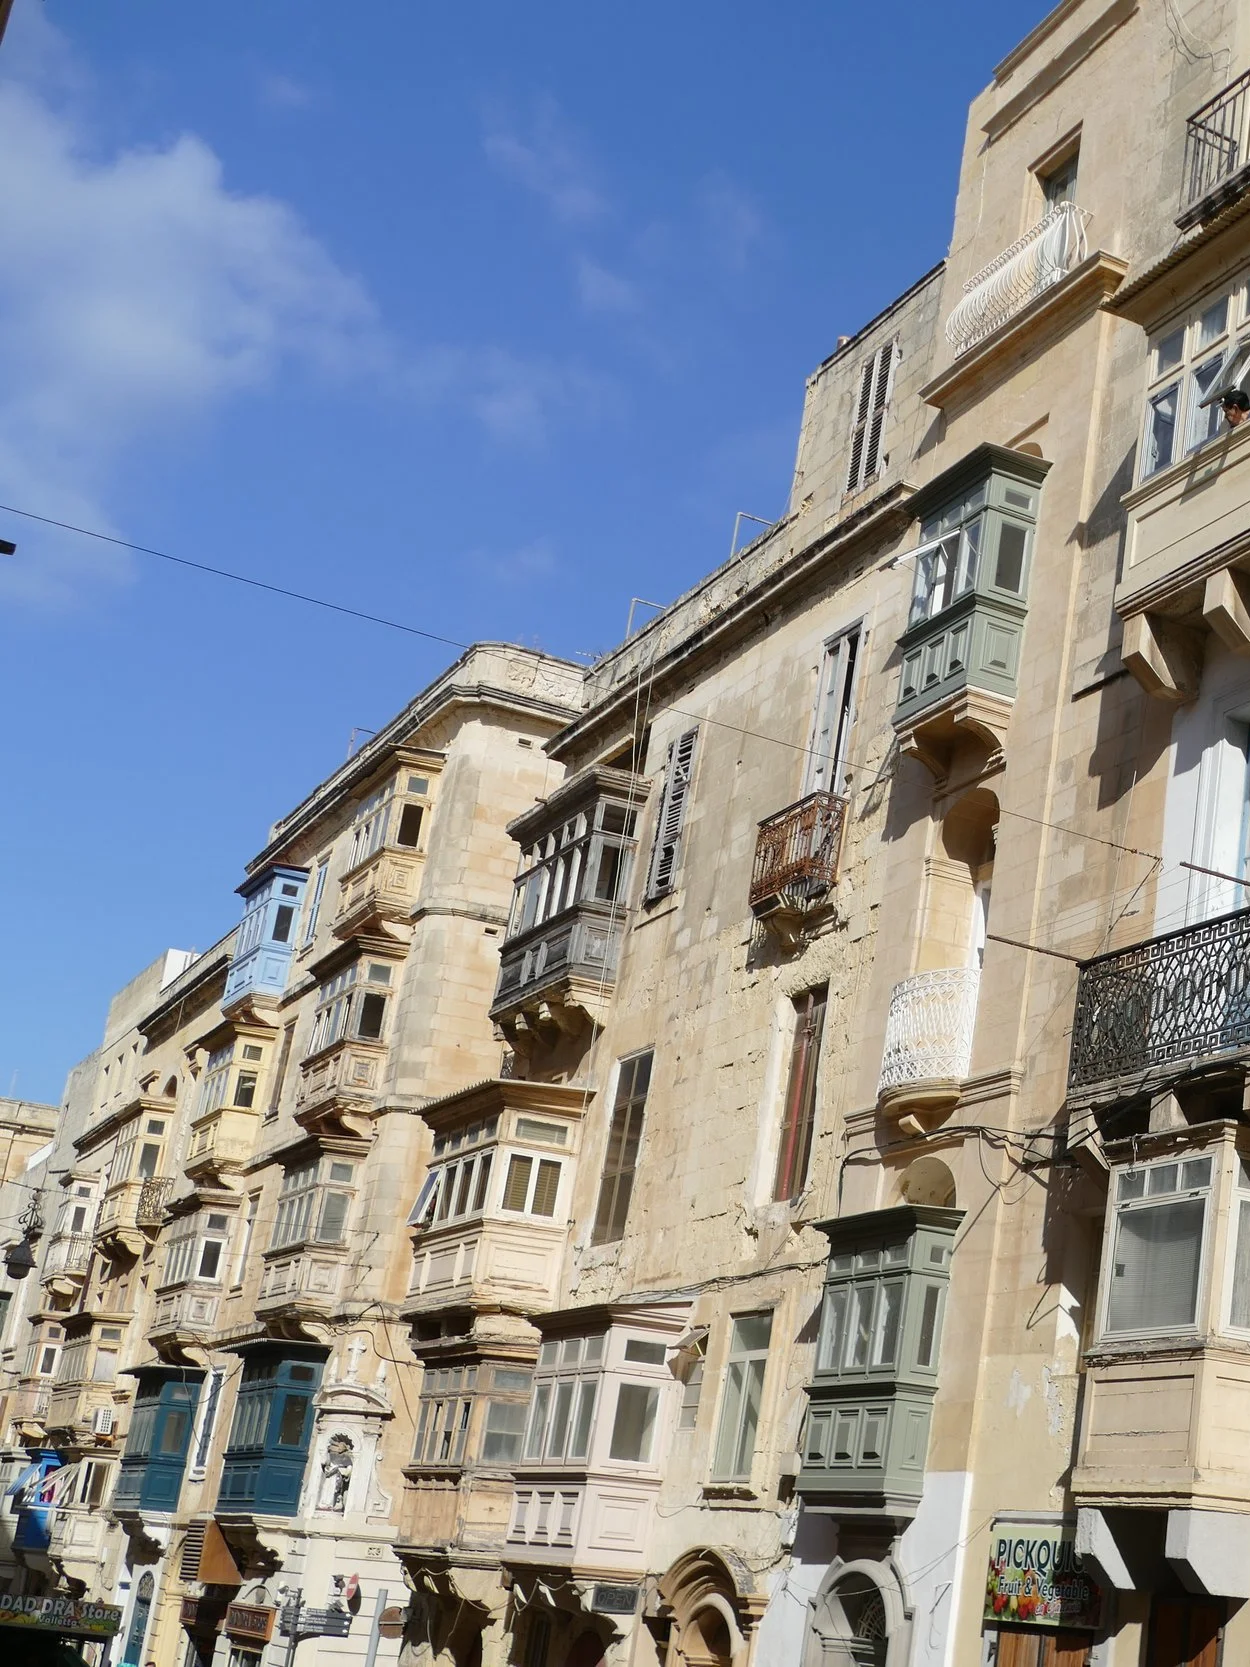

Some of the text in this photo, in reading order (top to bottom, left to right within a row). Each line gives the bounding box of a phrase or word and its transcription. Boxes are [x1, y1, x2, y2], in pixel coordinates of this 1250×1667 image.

[997, 1539, 1087, 1577] PICKQUIC
[597, 1589, 634, 1609] OPEN
[998, 1577, 1090, 1602] Fruit & Vegetable
[39, 1614, 77, 1626] Valletta
[41, 1598, 75, 1616] DRA
[81, 1602, 119, 1620] Store
